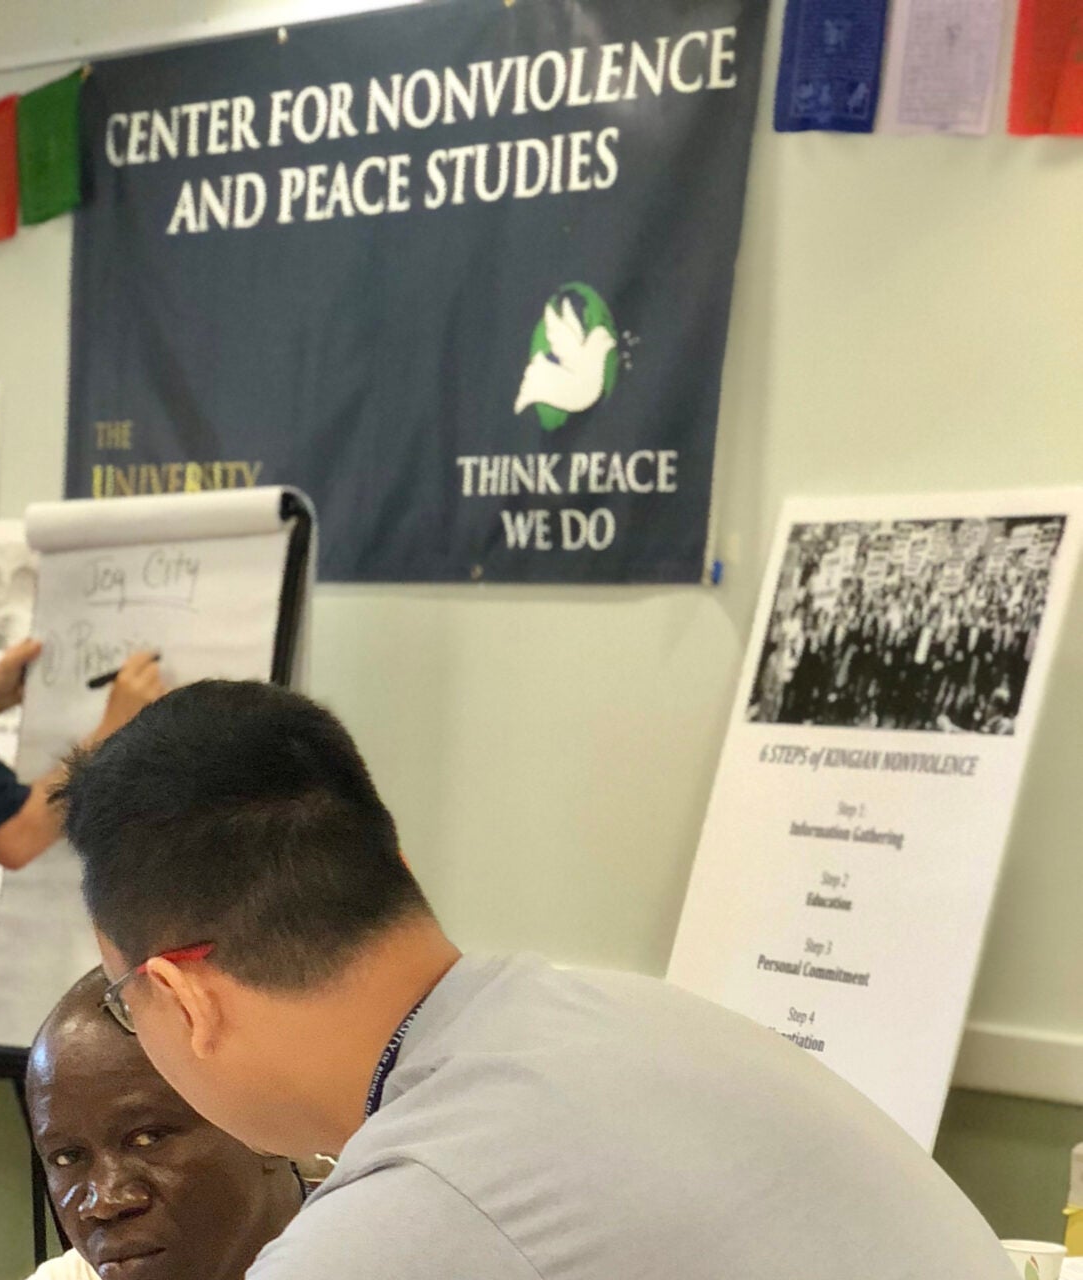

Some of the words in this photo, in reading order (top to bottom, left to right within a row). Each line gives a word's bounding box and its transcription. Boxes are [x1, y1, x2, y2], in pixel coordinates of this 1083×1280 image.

[105, 95, 260, 167] CENTER
[268, 81, 359, 147] FOR
[367, 26, 738, 137] NONVIOLENCE
[166, 174, 267, 235] AND
[277, 154, 411, 225] PEACE
[425, 127, 620, 209] STUDIES
[95, 419, 133, 449] THE
[92, 461, 263, 499] UNIVERSITY
[456, 454, 562, 497] THINK
[567, 450, 678, 494] PEACE
[501, 509, 552, 551] WE
[560, 508, 615, 550] DO
[768, 745, 809, 765] STEPS
[809, 747, 825, 771] of
[881, 752, 980, 776] NONVIOLENCE
[789, 821, 850, 841] Information
[852, 826, 905, 851] Gathering
[806, 892, 852, 911] Education
[804, 937, 825, 957] Step
[757, 954, 802, 976] Personal
[802, 961, 870, 987] Commitment
[787, 1006, 807, 1027] Step
[807, 1011, 816, 1025] 4
